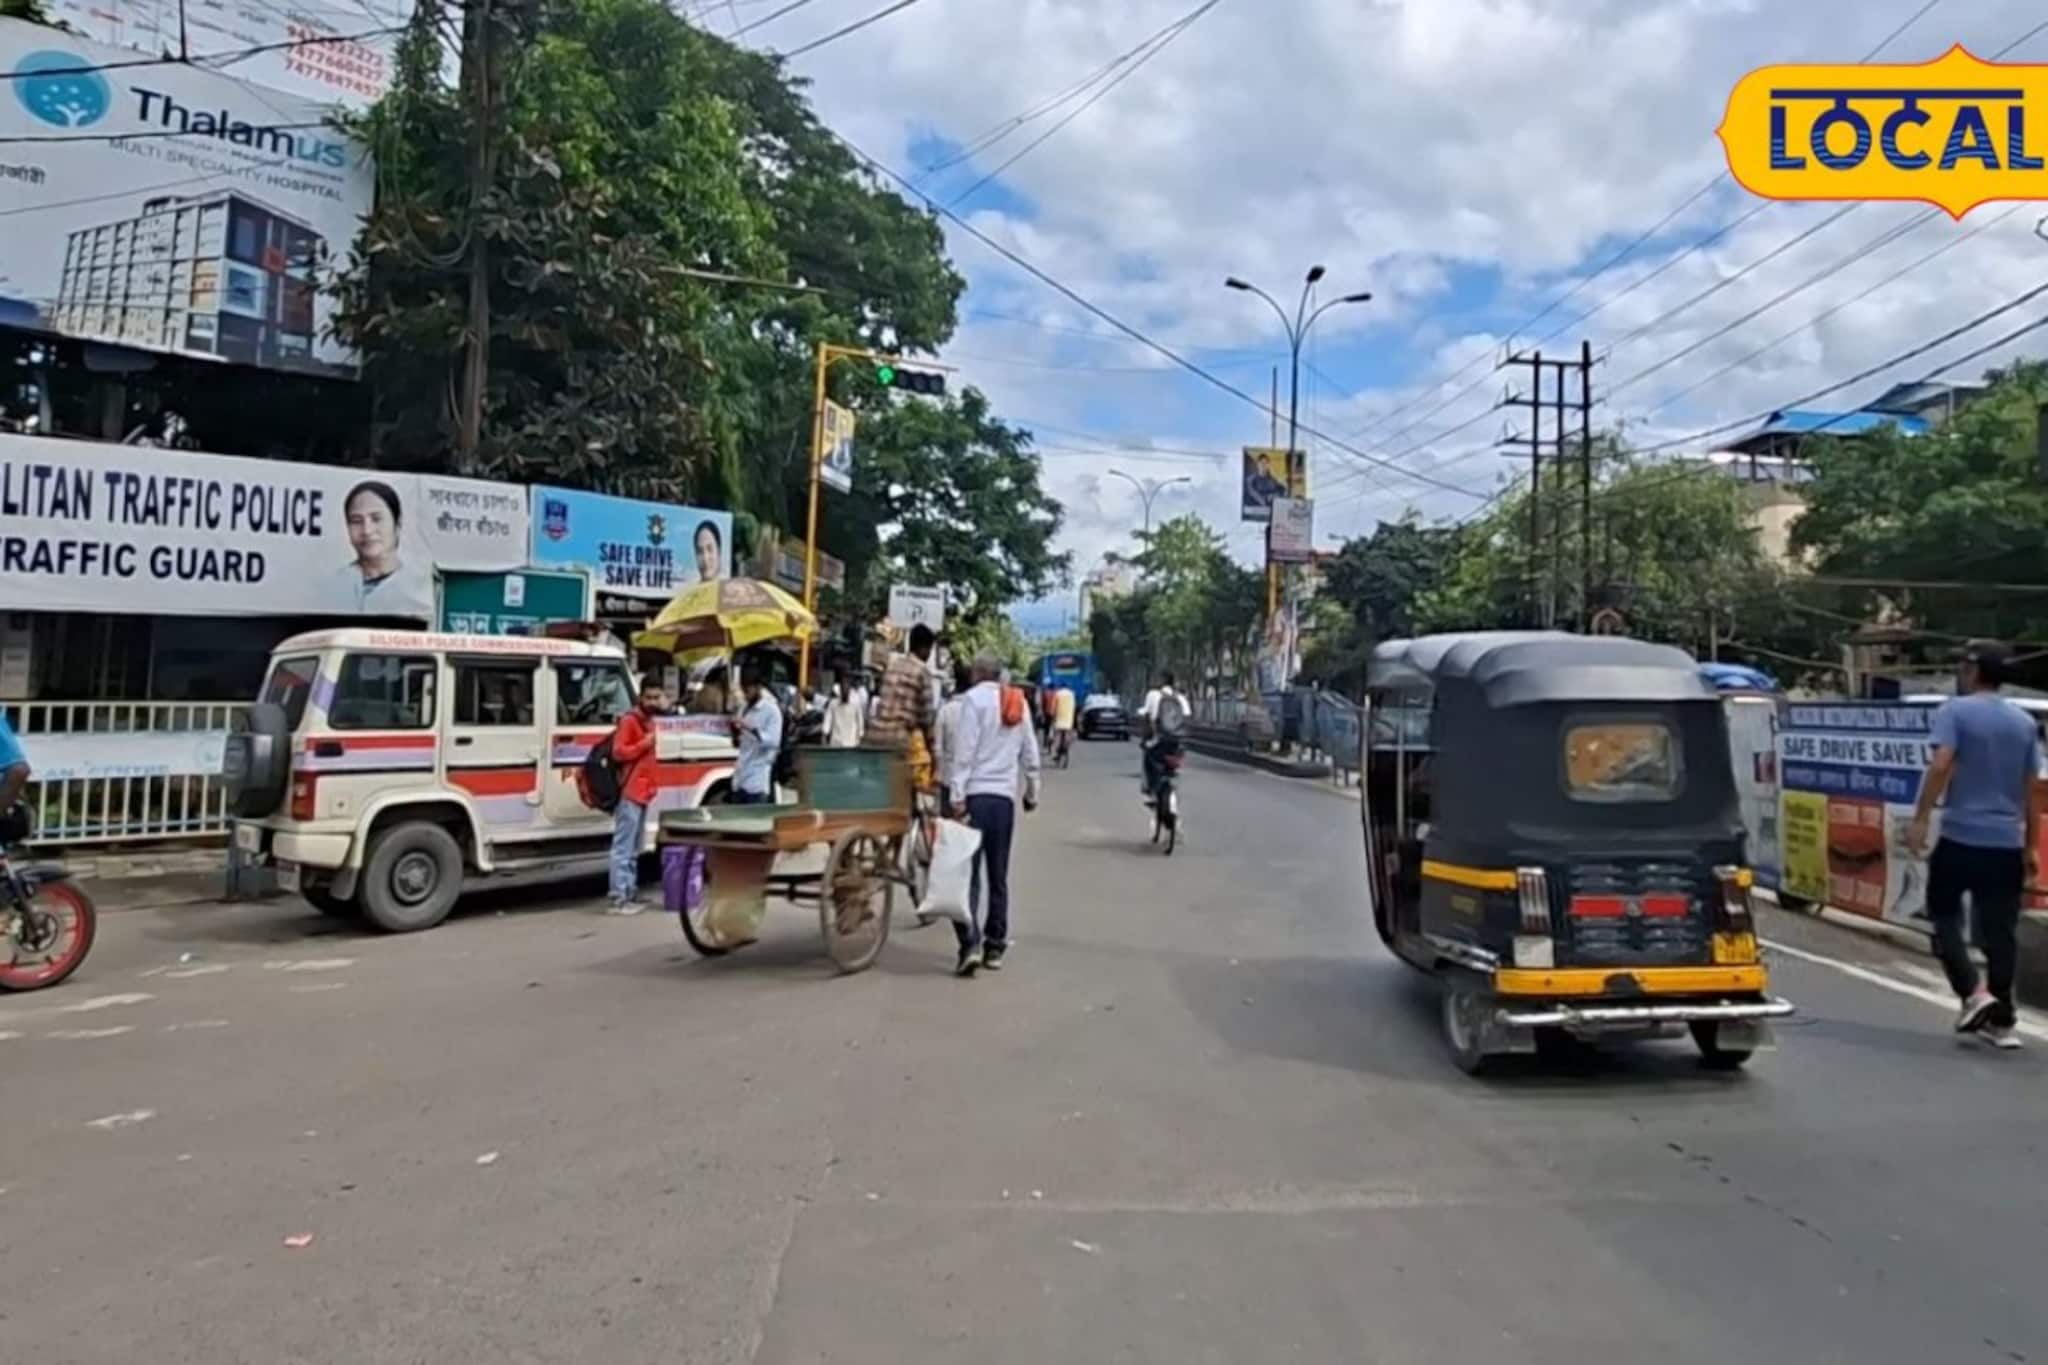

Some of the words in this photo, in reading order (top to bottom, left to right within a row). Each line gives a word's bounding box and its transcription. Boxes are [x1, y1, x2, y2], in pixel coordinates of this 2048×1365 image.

[129, 86, 346, 168] Thalamus
[109, 138, 162, 160] MULTI
[166, 149, 264, 183] SPECIALITY
[266, 173, 345, 202] HOSPITAL
[2, 461, 94, 521] LITAN
[104, 471, 222, 530] TRAFFIC
[230, 482, 323, 536] POLICE
[0, 536, 137, 578] RAFFIC
[149, 545, 265, 584] GUARD
[598, 542, 632, 564] SAFE
[635, 545, 672, 568] DRIVE
[605, 563, 642, 587] SAVE
[646, 567, 672, 589] LIFE
[368, 634, 422, 649] SILIGURI
[427, 634, 468, 650] POLICE
[1783, 736, 1816, 757] SAFE
[1820, 738, 1867, 762] DRIVE
[1871, 741, 1916, 766] SAVE
